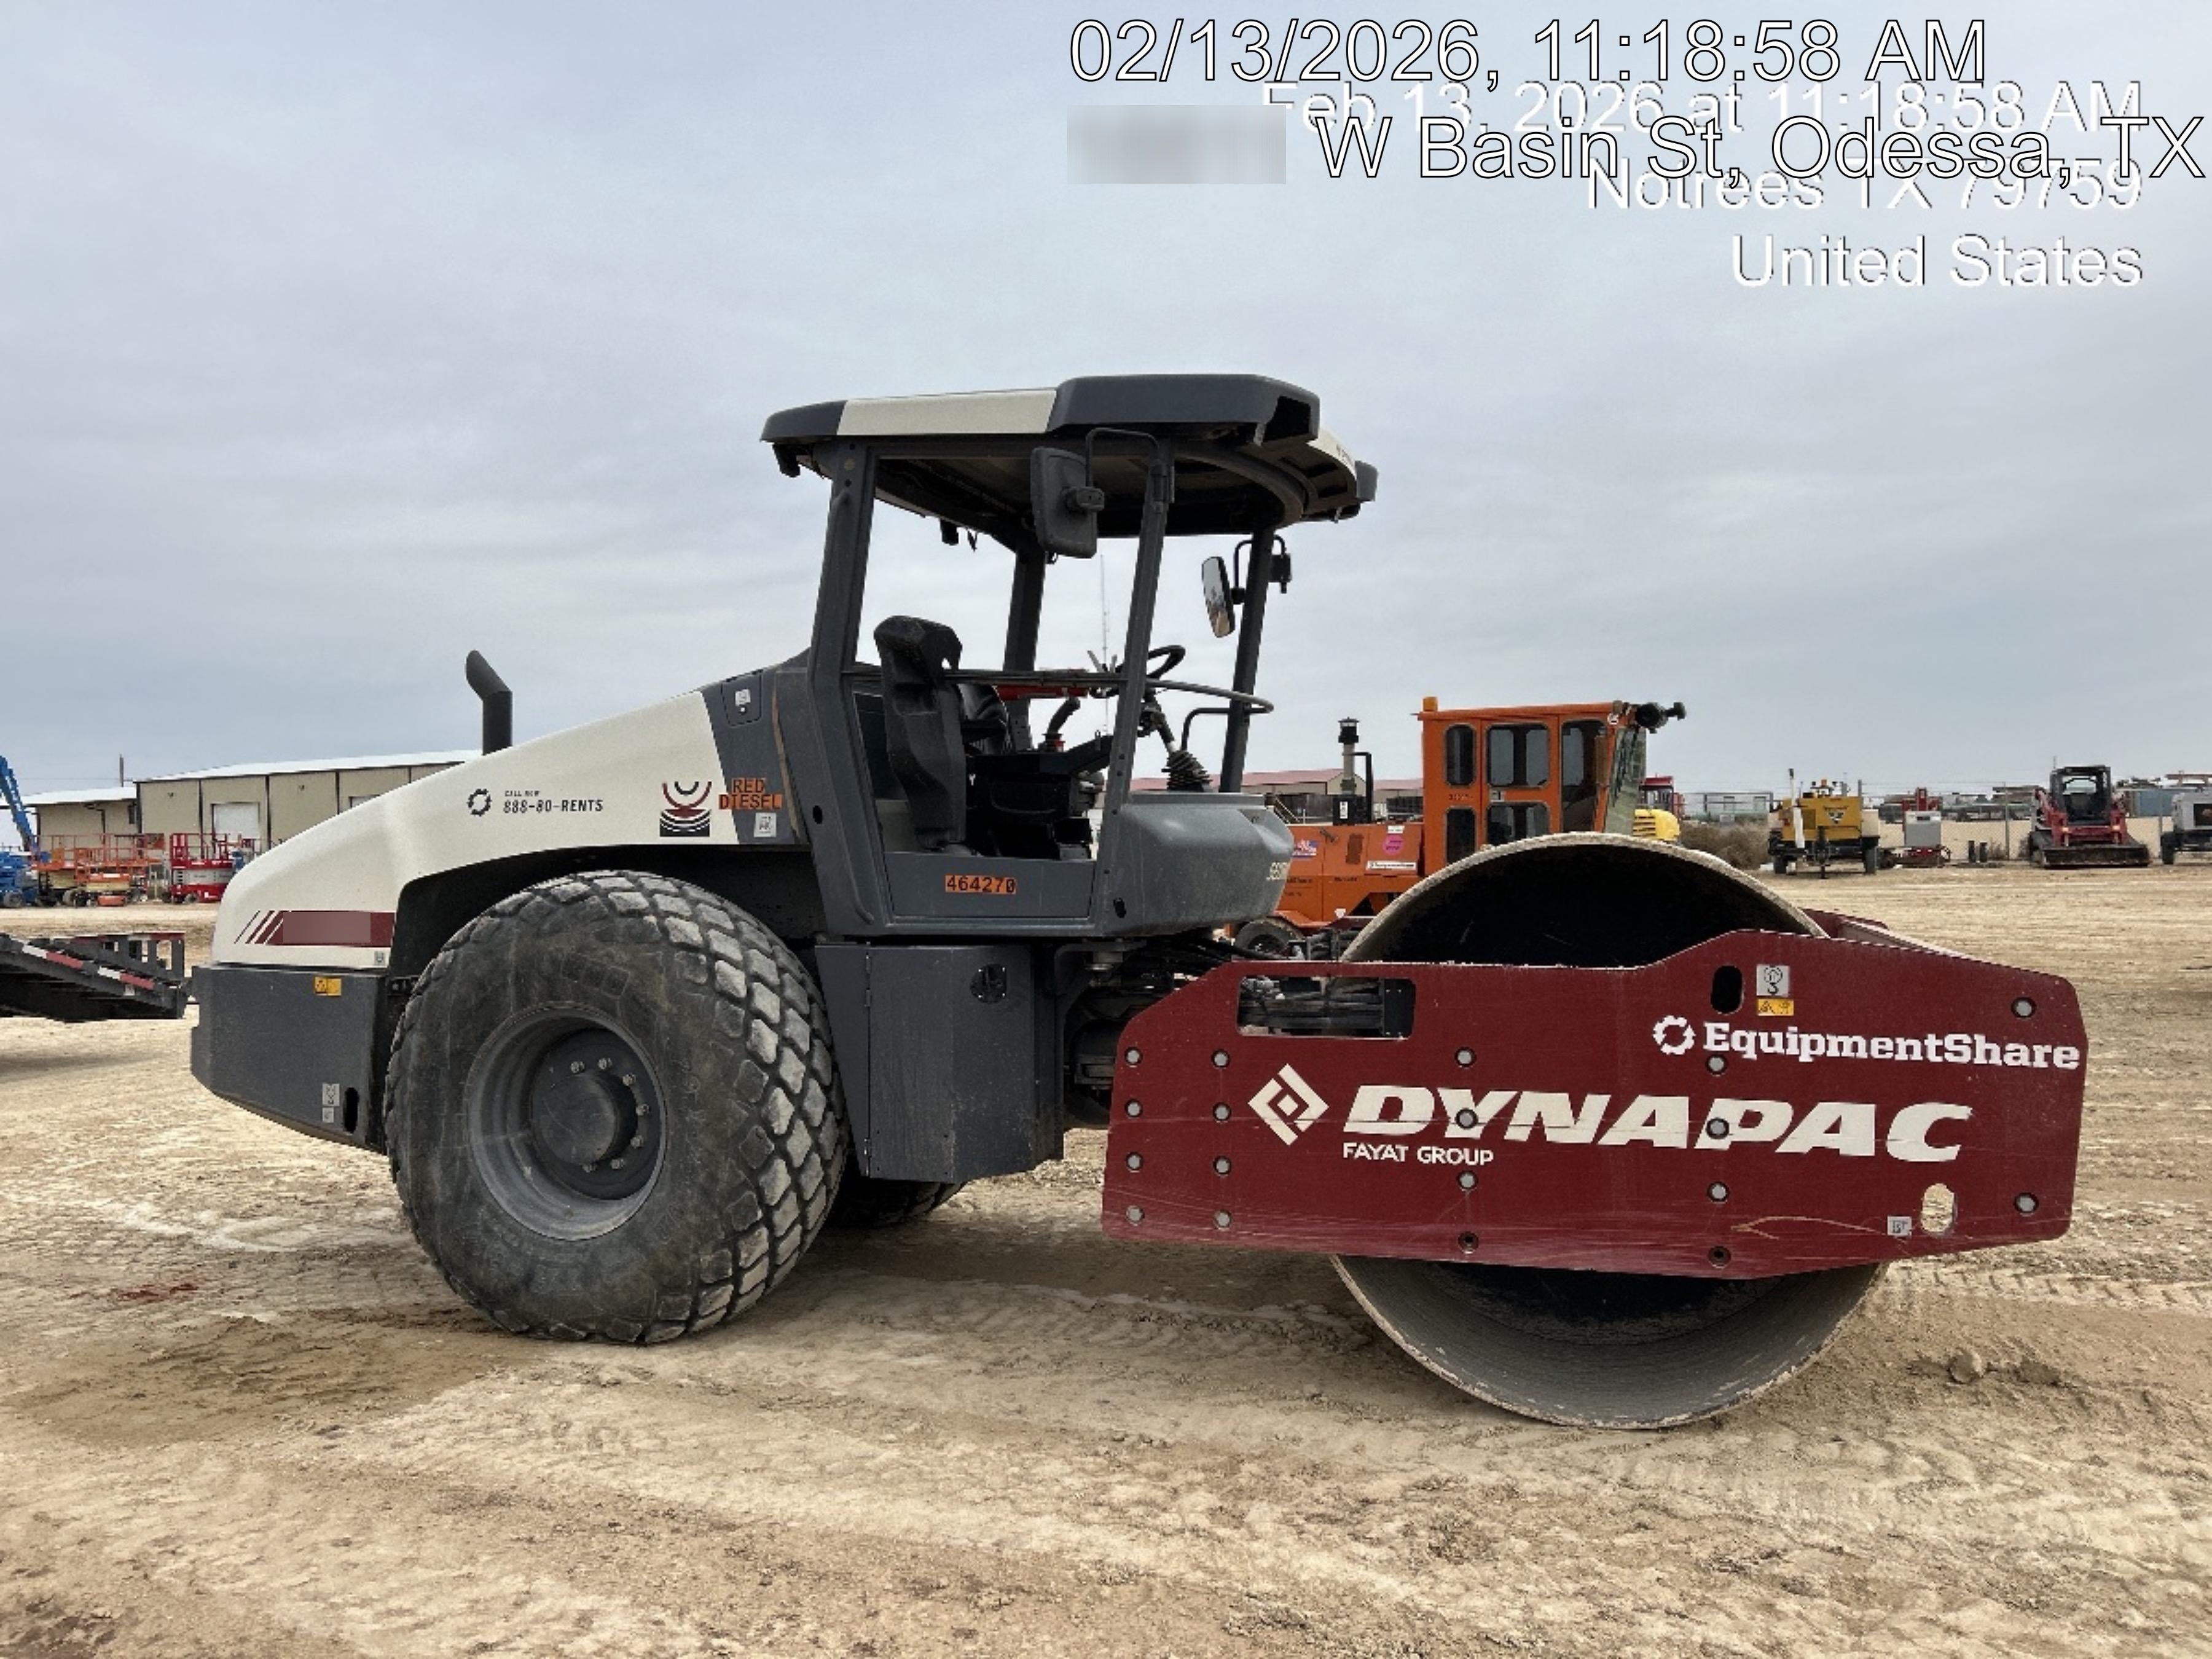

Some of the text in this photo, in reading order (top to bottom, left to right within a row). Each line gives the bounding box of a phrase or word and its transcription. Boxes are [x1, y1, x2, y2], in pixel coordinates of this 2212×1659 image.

[733, 779, 764, 793] RED
[503, 799, 603, 814] 888-80-RENTS
[719, 794, 781, 809] DIESEL
[947, 875, 1014, 893] 464270
[1703, 1022, 2080, 1070] EquipmentShare
[1343, 1085, 1974, 1162] DYNAPAC
[1343, 1142, 1494, 1166] FAYAT GROUP
